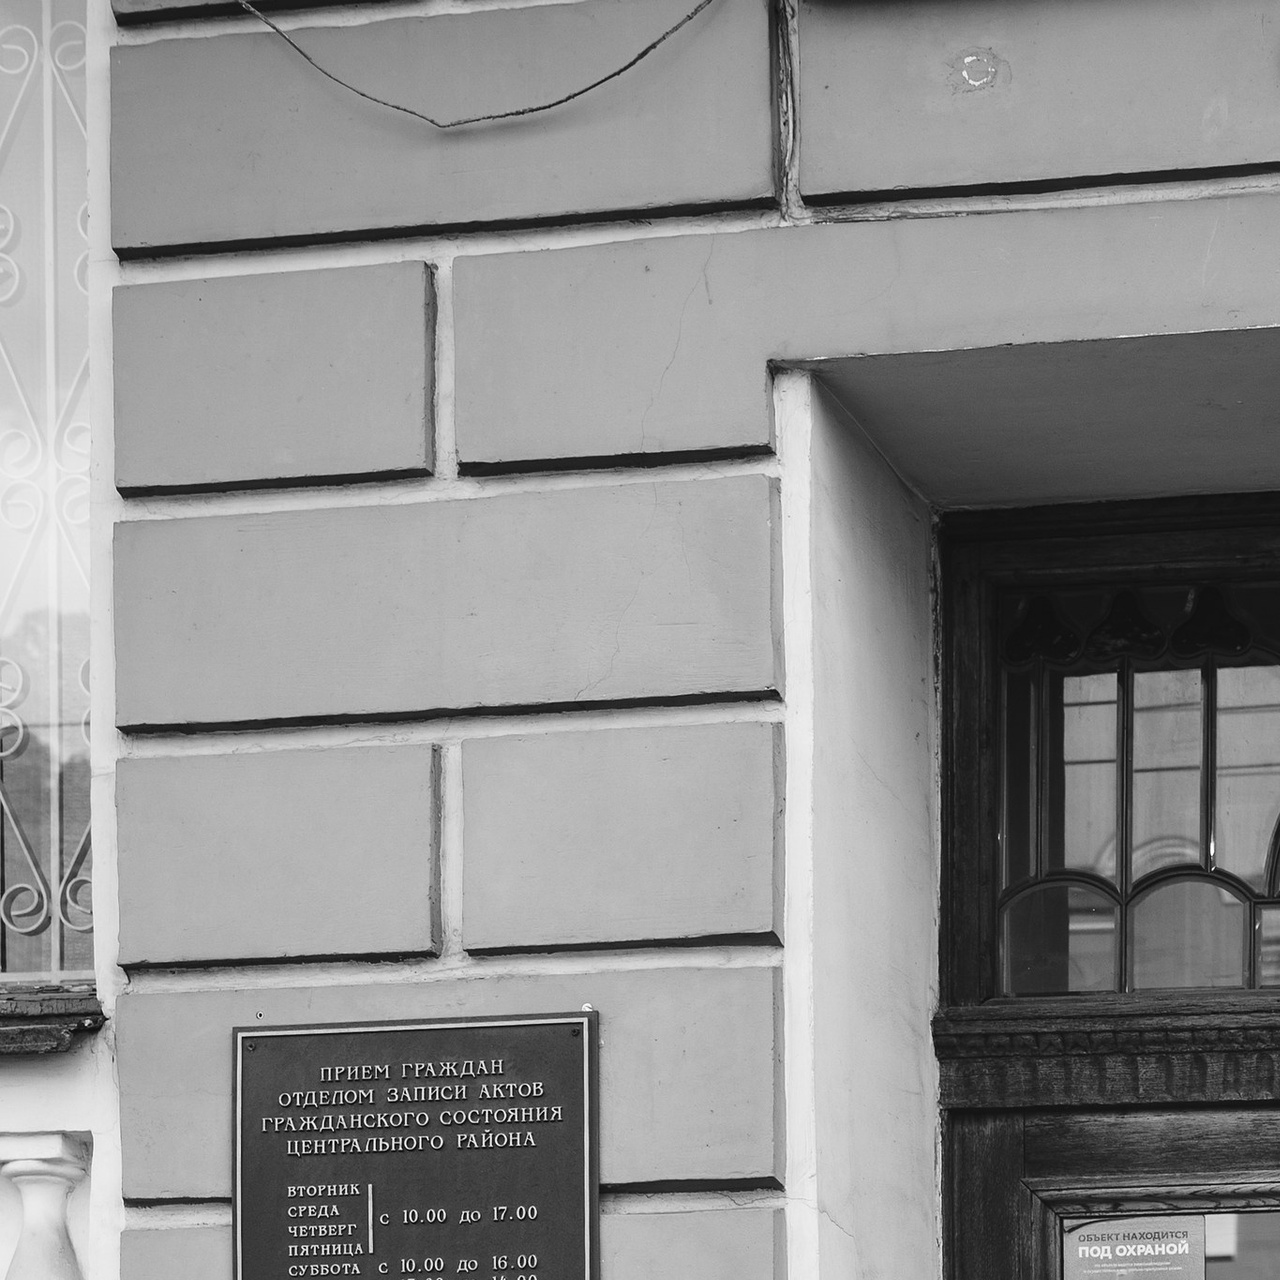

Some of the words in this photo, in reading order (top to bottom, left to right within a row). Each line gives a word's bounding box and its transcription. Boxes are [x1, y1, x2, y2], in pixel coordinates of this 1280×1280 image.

[320, 1064, 389, 1082] ПРИЕМ
[401, 1059, 503, 1078] ГРАЖДАН
[278, 1089, 374, 1109] ОТДЕЛОМ
[387, 1084, 467, 1102] ЗАПИСИ
[479, 1081, 544, 1099] АКТОВ
[262, 1112, 429, 1133] ГРАЖДАНСКОГО
[439, 1106, 562, 1125] СОСТОЯНИЯ
[287, 1135, 444, 1157] ЦЕНТРАЛЬНОГО
[457, 1129, 536, 1148] РАЙОНА
[287, 1183, 360, 1197] ВТОРНИК
[287, 1204, 340, 1219] СРЕДА
[403, 1208, 447, 1224] 10.00
[493, 1205, 538, 1221] 17.00
[288, 1223, 357, 1237] ЧЕТВЕРГ
[1078, 1232, 1120, 1243] ОБЪЕКТ
[1122, 1230, 1189, 1242] НАХОДИТСЯ
[288, 1243, 364, 1257] ПЯТНИЦА
[1078, 1245, 1113, 1260] ПОД
[1115, 1240, 1190, 1257] ОХРАНОЙ
[288, 1263, 361, 1277] СУББОТА
[400, 1257, 444, 1273] 10.00
[492, 1254, 538, 1270] 16.00
